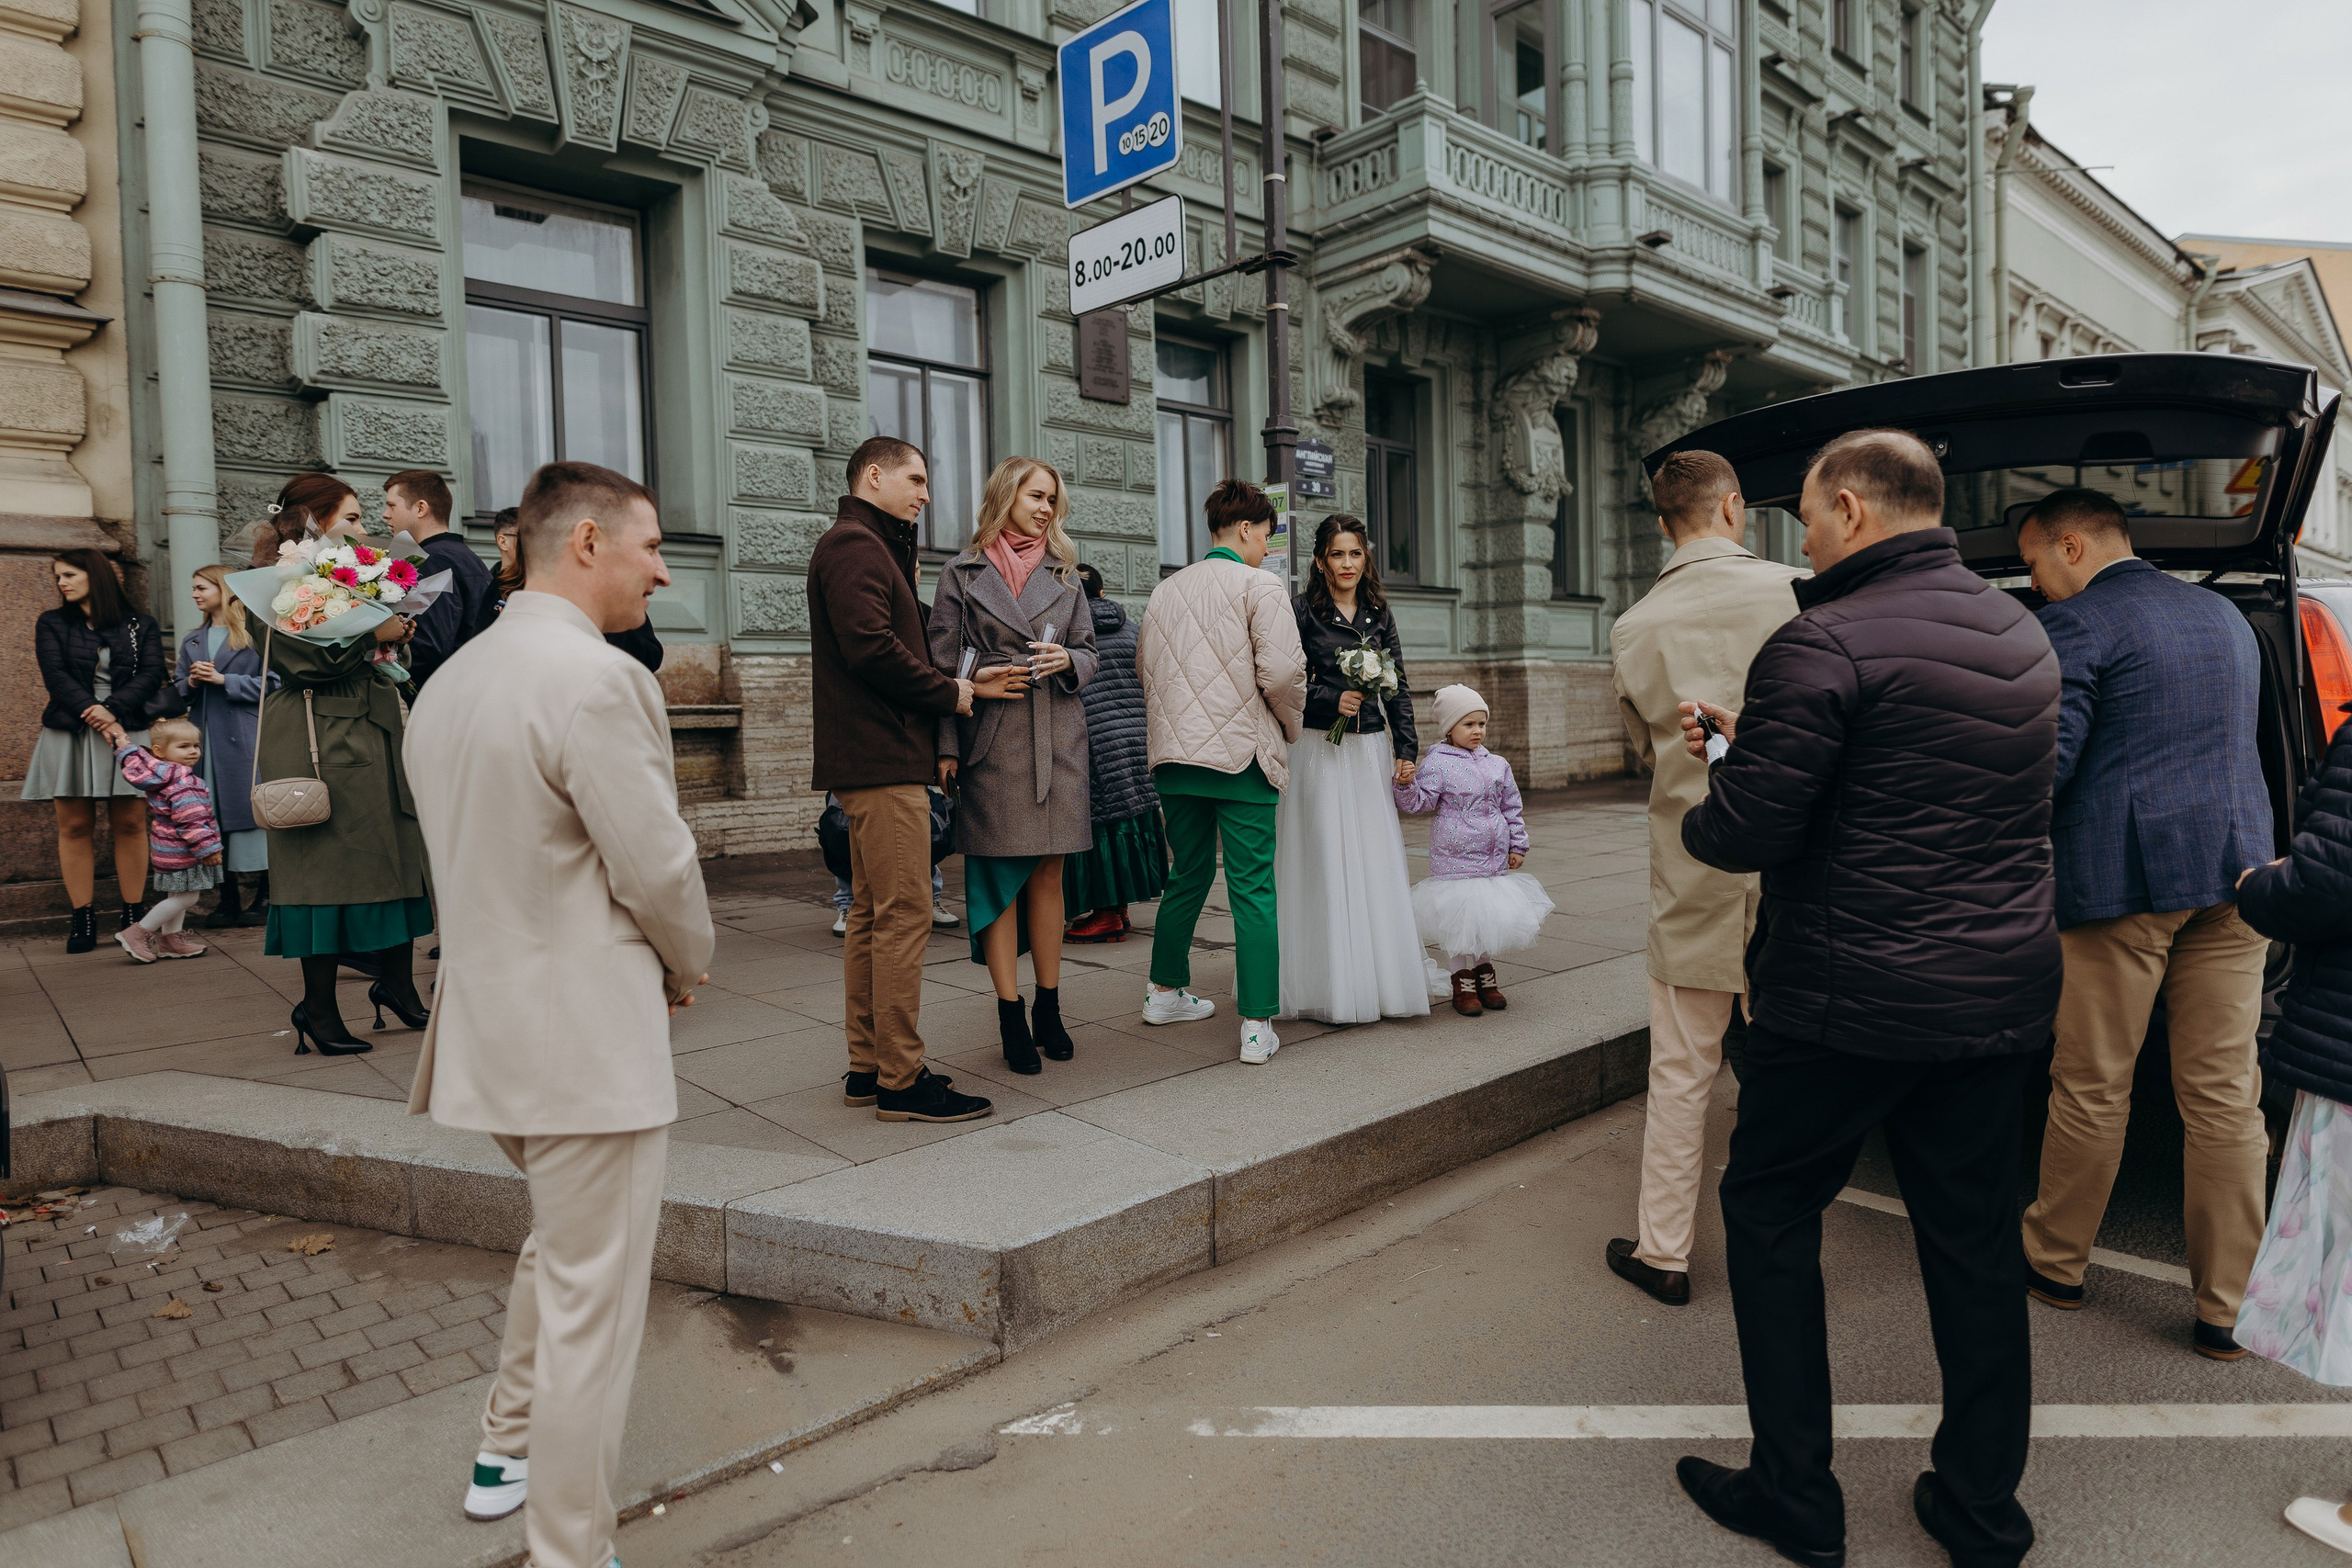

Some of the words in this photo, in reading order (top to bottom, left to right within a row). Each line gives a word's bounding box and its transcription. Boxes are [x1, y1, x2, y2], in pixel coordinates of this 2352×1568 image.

[1089, 30, 1152, 175] P
[1122, 137, 1131, 150] 10
[1134, 129, 1146, 146] 15
[1149, 118, 1169, 141] 20
[1075, 231, 1175, 287] 8.00-20.00
[1311, 481, 1321, 493] 30
